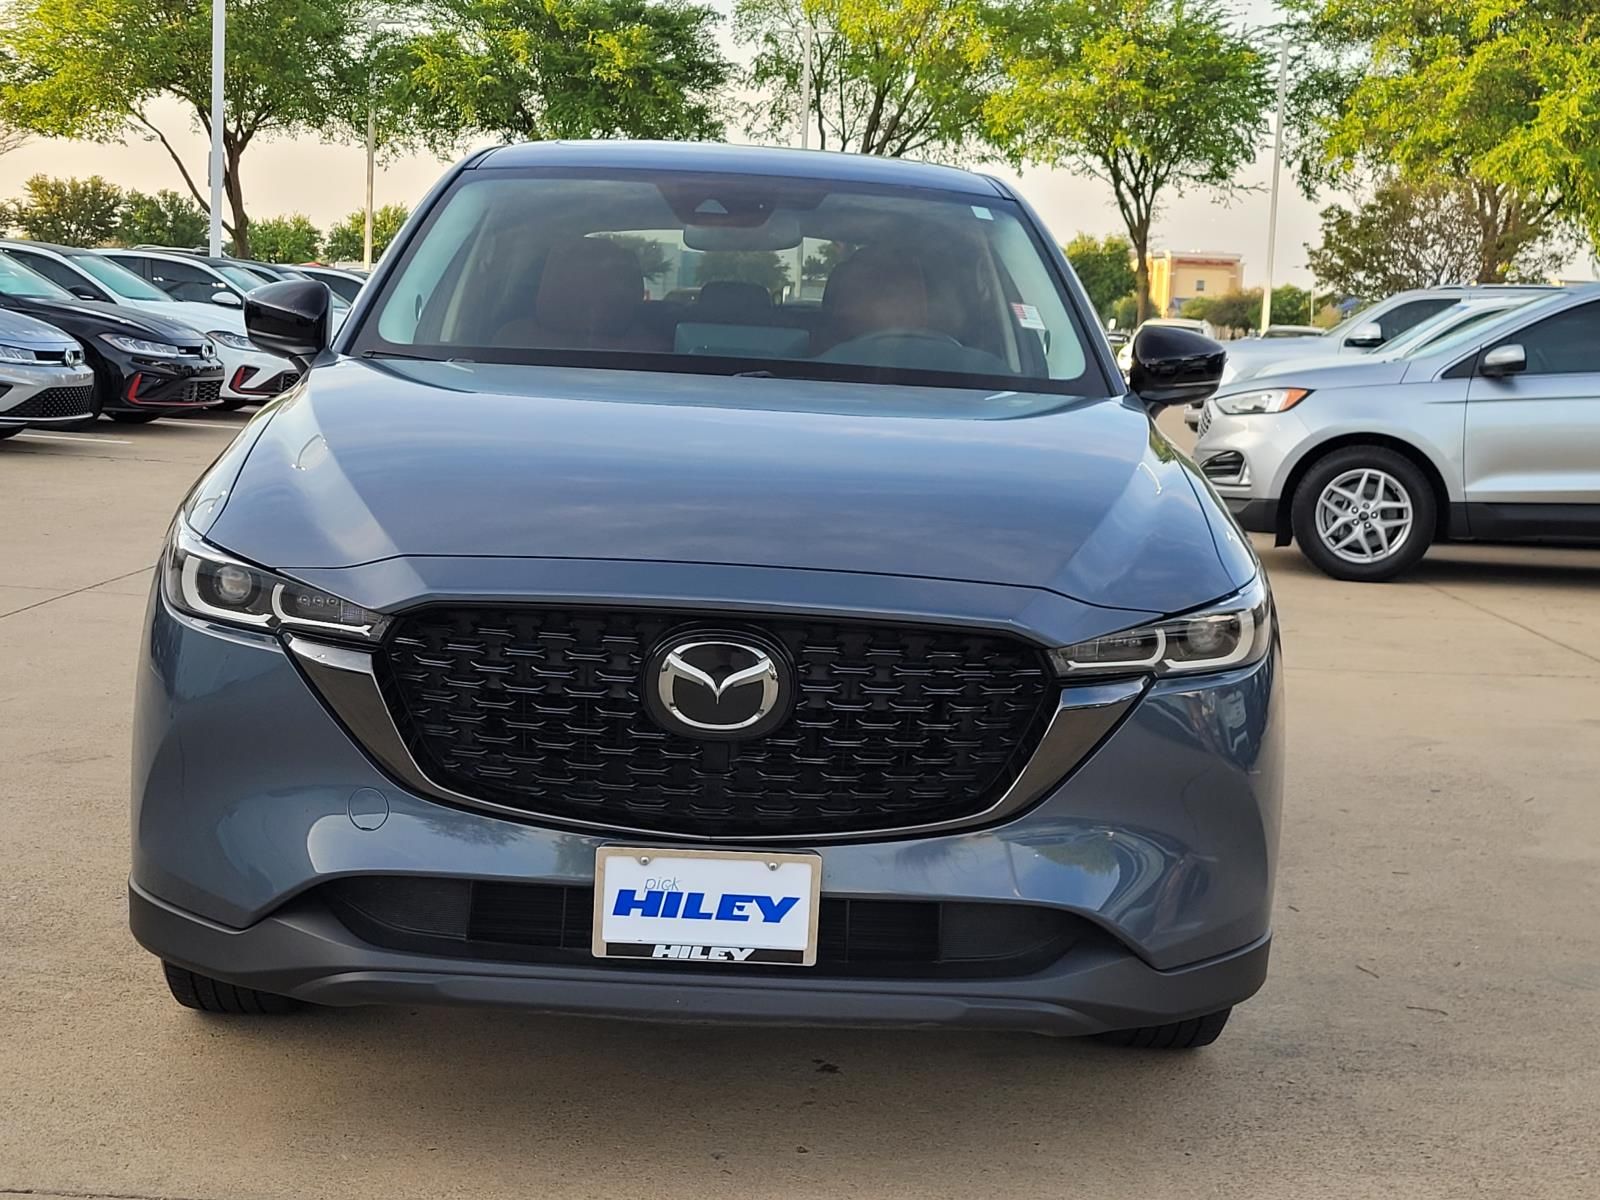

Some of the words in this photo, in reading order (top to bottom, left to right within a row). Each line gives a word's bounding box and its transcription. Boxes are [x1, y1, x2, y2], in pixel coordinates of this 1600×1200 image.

[644, 876, 682, 892] pick
[612, 889, 800, 923] HILEY
[652, 944, 755, 961] HILEY
